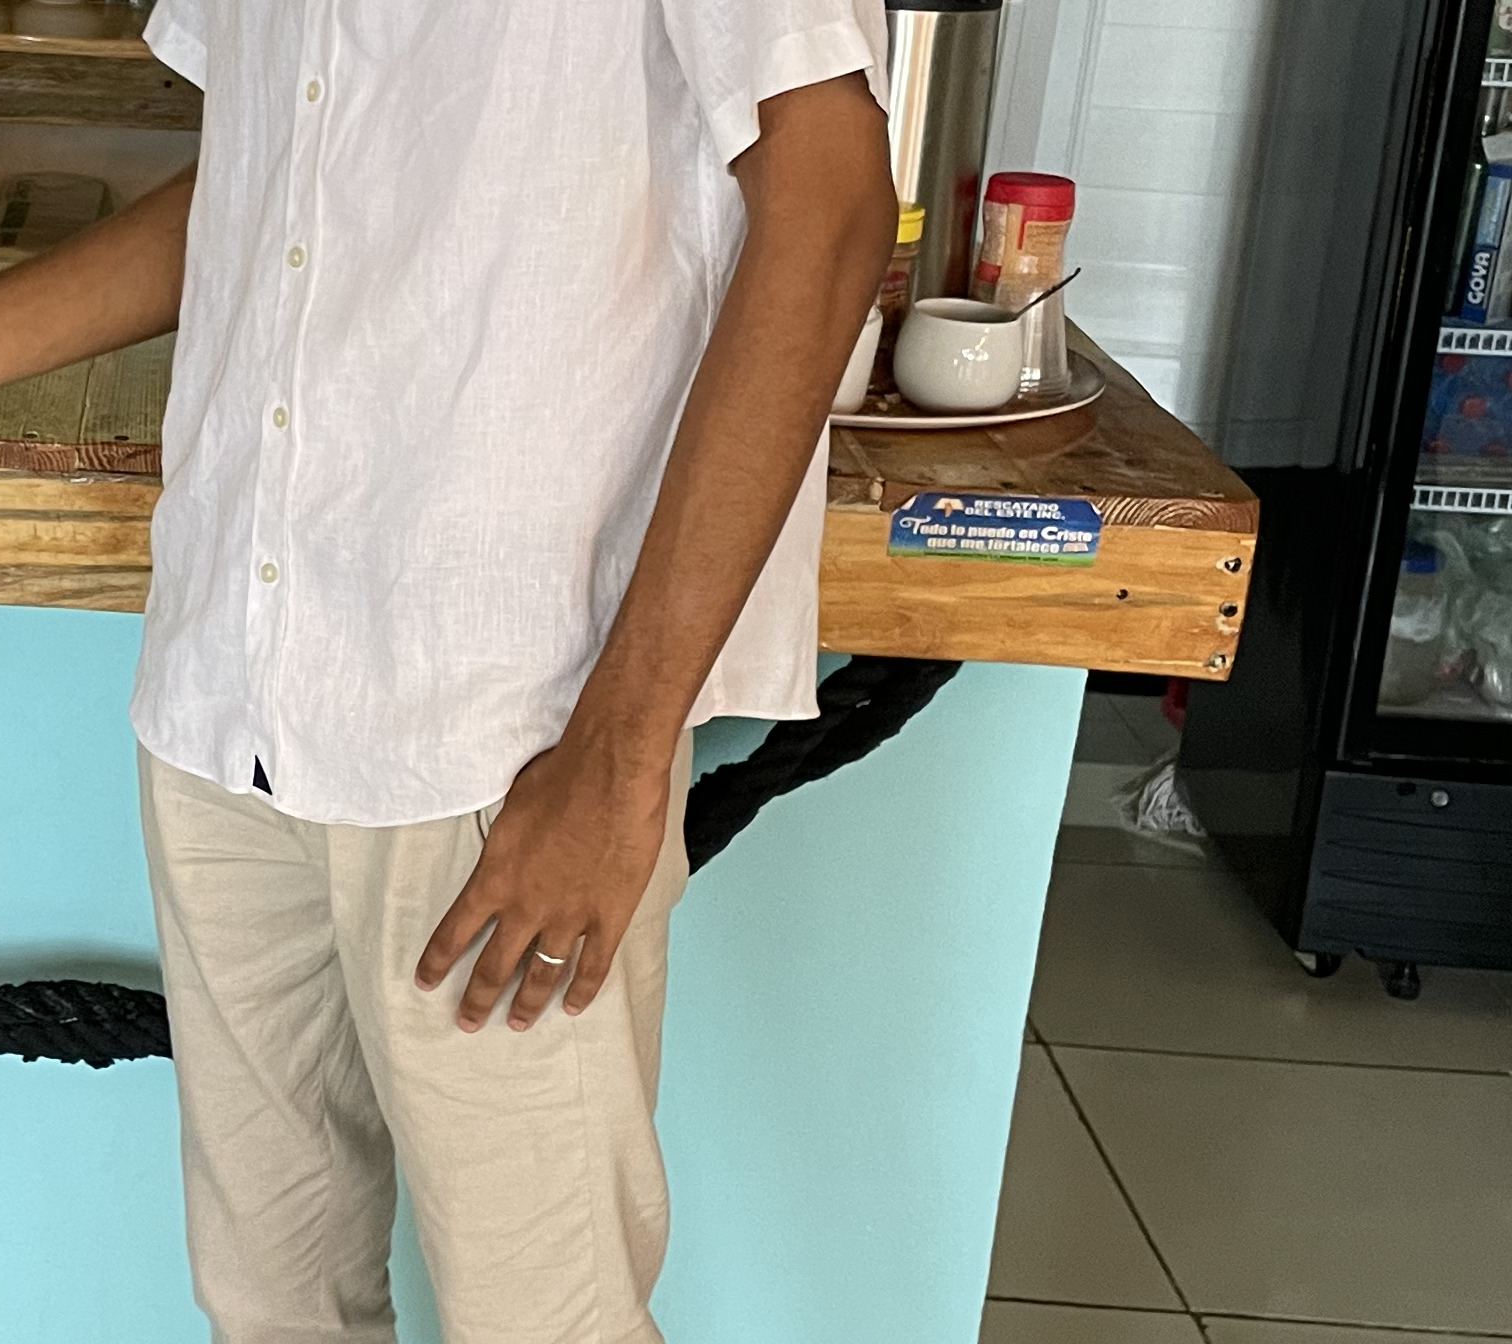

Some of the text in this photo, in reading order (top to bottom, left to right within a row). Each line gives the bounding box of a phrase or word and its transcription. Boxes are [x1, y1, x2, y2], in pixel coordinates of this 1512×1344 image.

[1467, 251, 1491, 305] GOYA
[965, 507, 1066, 521] DEL ESTE INC.
[973, 500, 1059, 512] RESCATADO
[899, 516, 1093, 542] Todo lo puedo en Cristo
[927, 537, 1060, 554] que me fortalece
